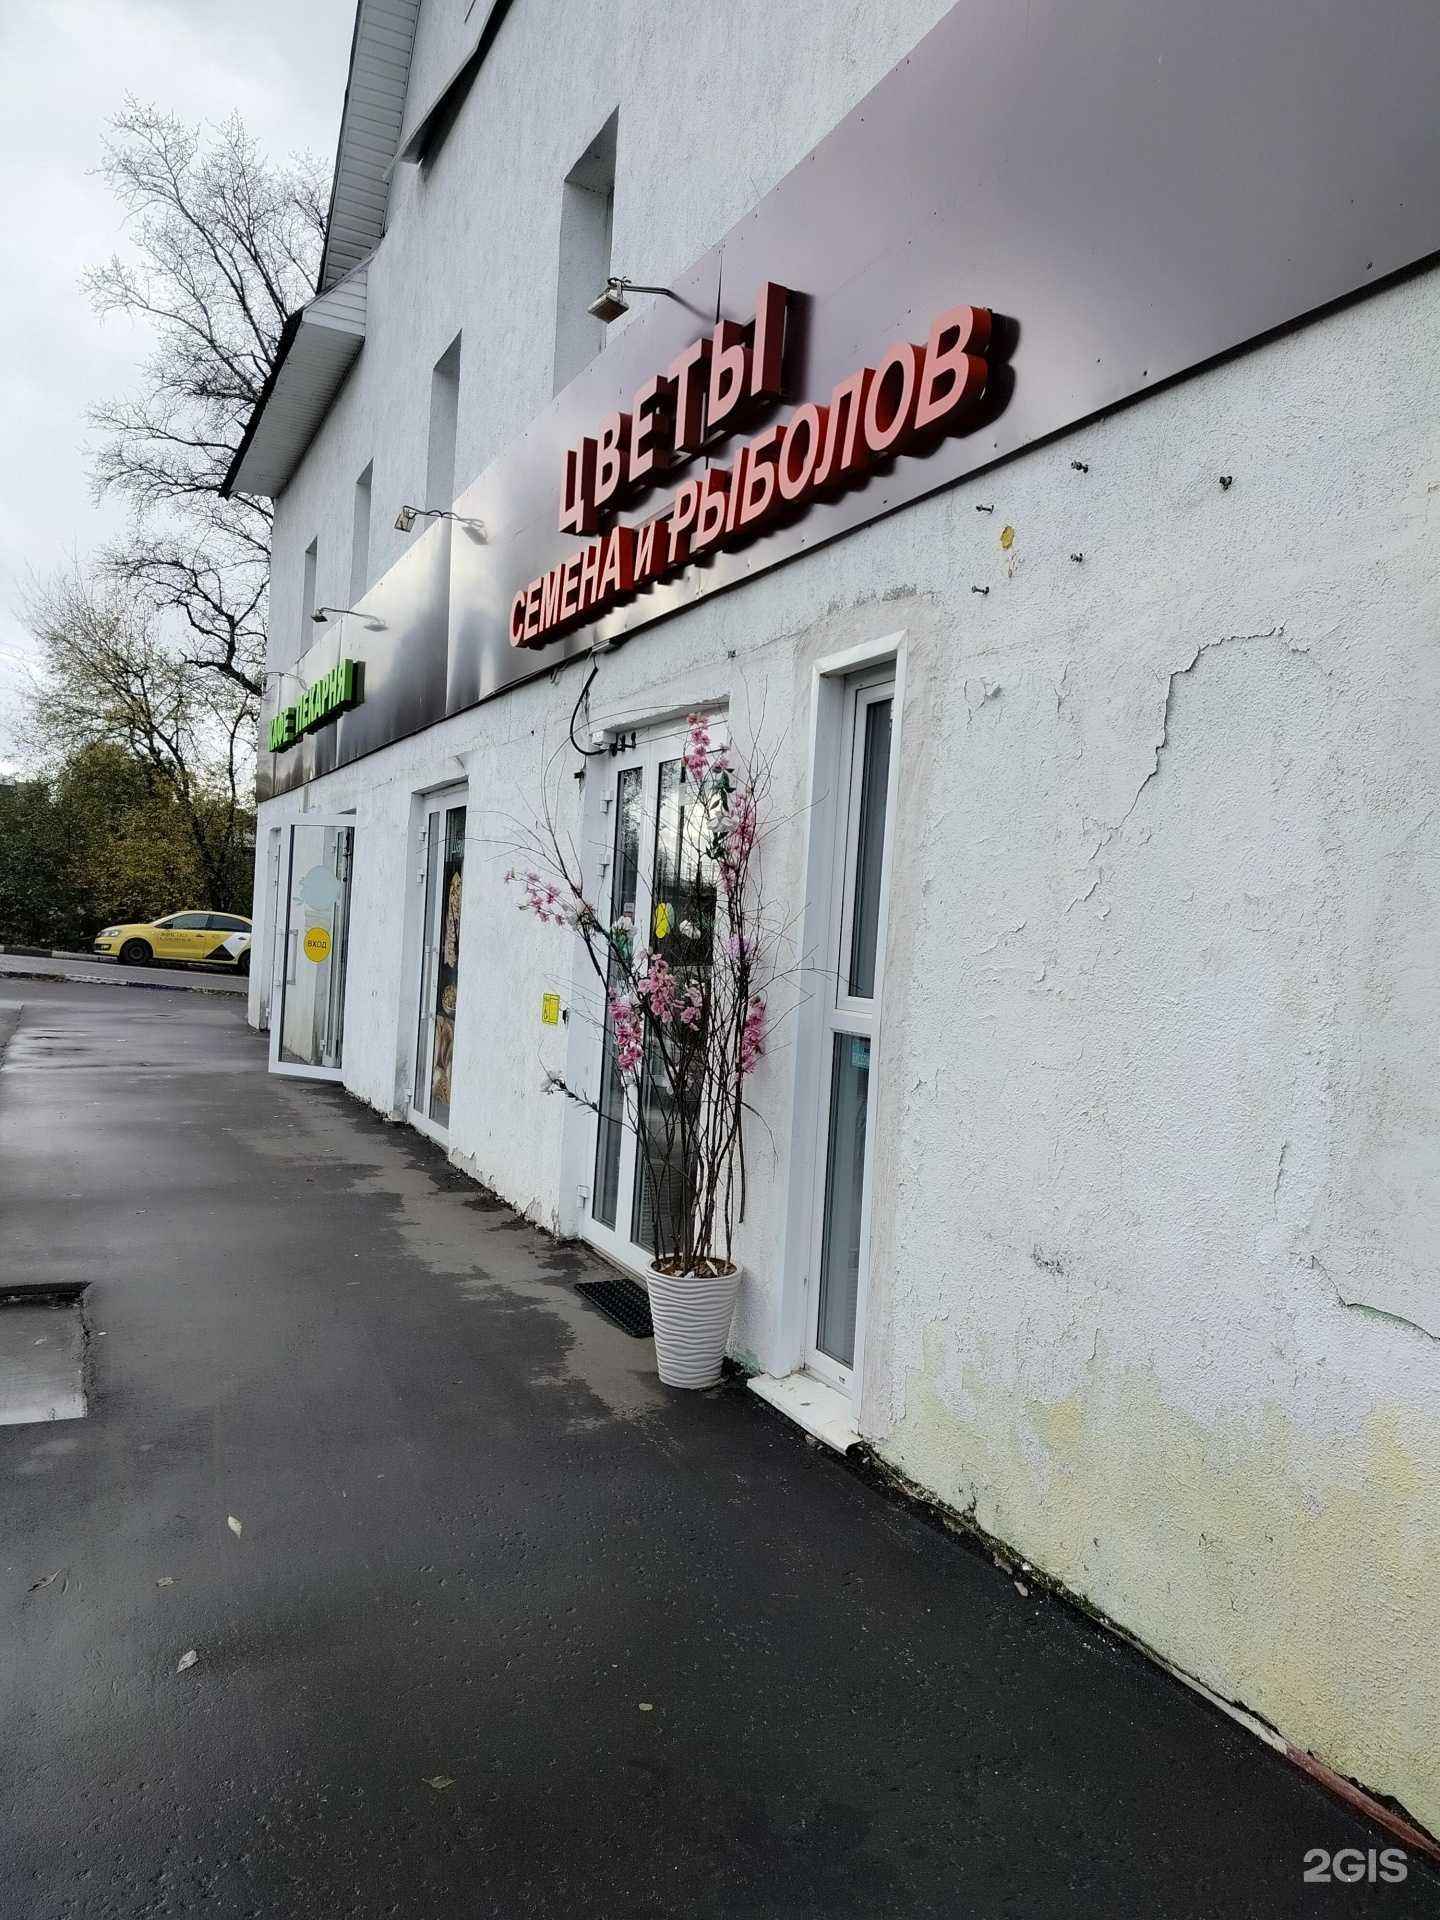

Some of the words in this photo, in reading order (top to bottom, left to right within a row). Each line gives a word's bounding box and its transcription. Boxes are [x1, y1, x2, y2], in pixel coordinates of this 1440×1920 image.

[509, 526, 622, 648] СЕМЕНА
[634, 519, 658, 582] И
[667, 303, 978, 563] РЫБОЛОВ
[559, 281, 775, 535] ЦВЕТЫ
[296, 658, 348, 734] ПЕКАРНЯ
[307, 939, 327, 949] ВХОД
